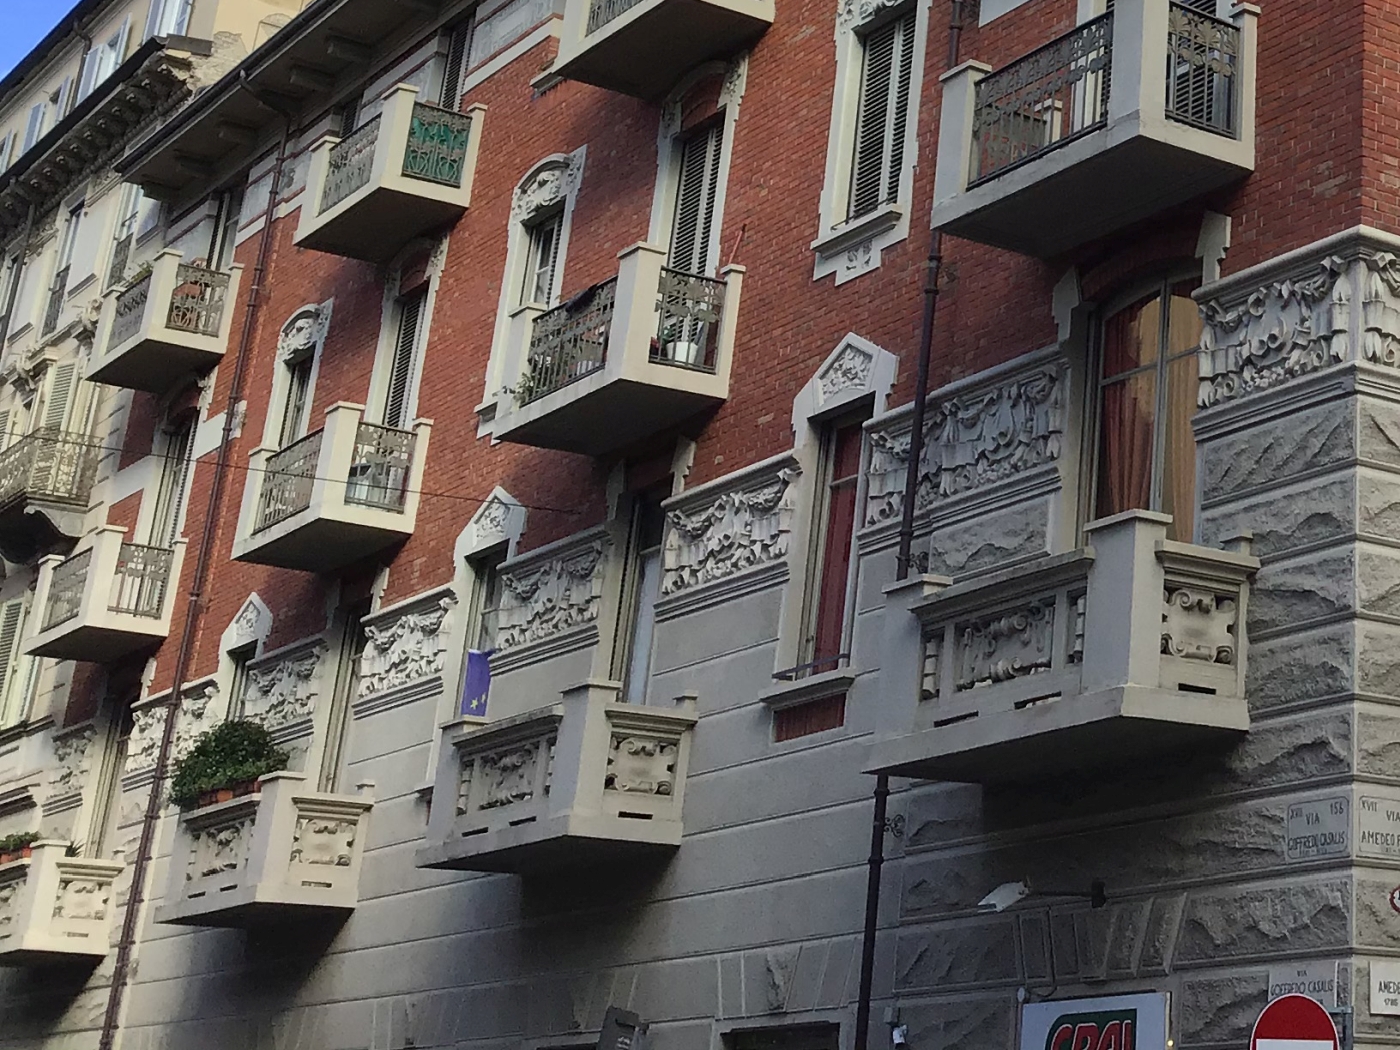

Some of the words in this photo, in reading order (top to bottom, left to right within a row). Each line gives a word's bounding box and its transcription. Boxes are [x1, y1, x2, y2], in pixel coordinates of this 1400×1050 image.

[1330, 801, 1344, 815] 156
[1305, 812, 1320, 825] VIA
[1386, 810, 1400, 822] VIA
[1361, 830, 1395, 846] AMEDEO
[1270, 981, 1306, 997] GOFFREDO
[1307, 979, 1334, 993] CASALIS
